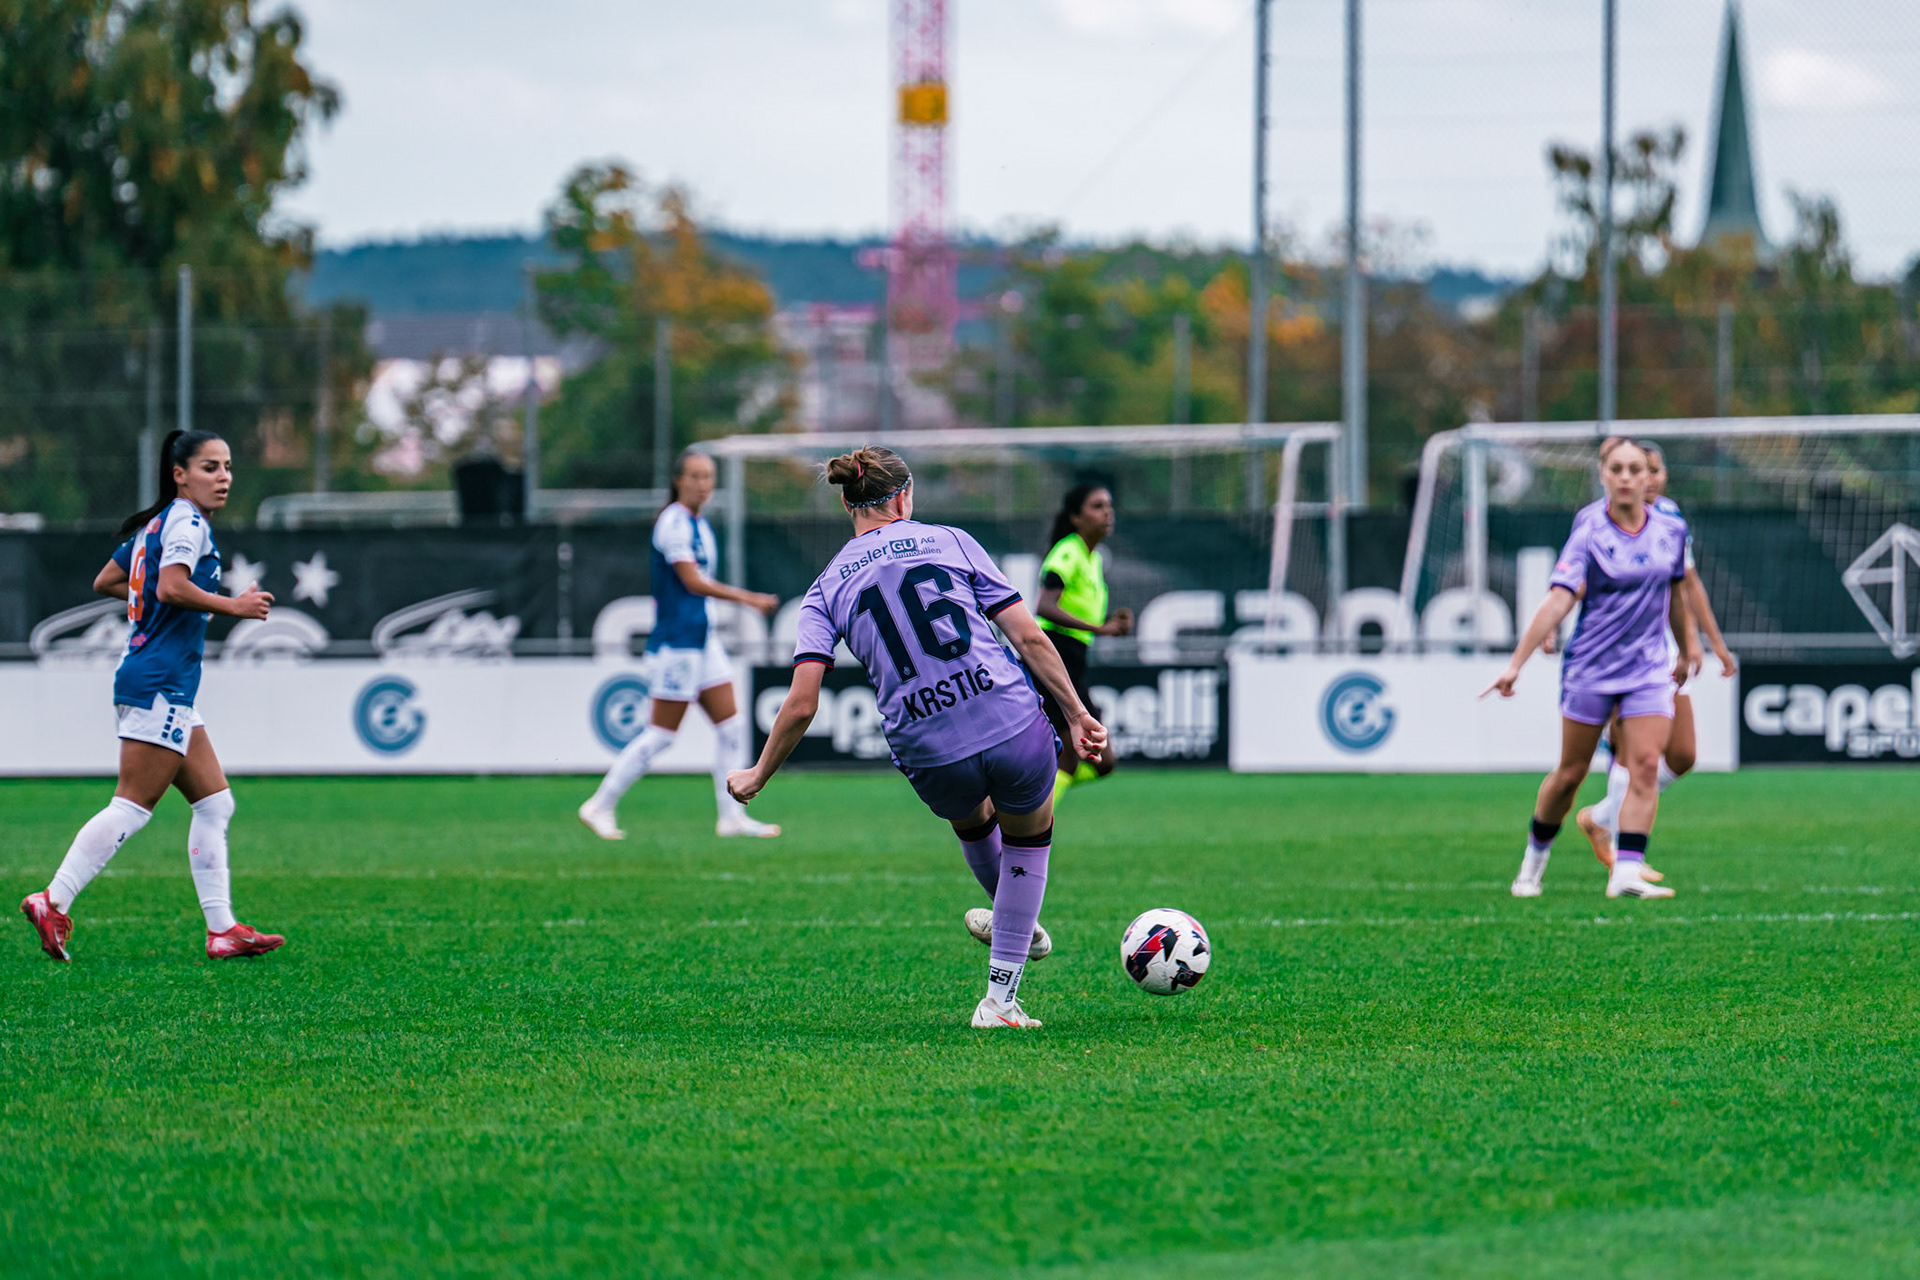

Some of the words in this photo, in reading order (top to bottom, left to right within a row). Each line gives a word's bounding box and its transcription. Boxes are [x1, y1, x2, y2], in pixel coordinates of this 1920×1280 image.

[839, 544, 889, 580] Basler
[890, 539, 916, 552] GU
[920, 536, 935, 545] AG
[893, 547, 942, 560] Immobilien
[857, 563, 972, 684] 16
[902, 663, 995, 722] KRSTIĆ
[989, 966, 1012, 985] FS
